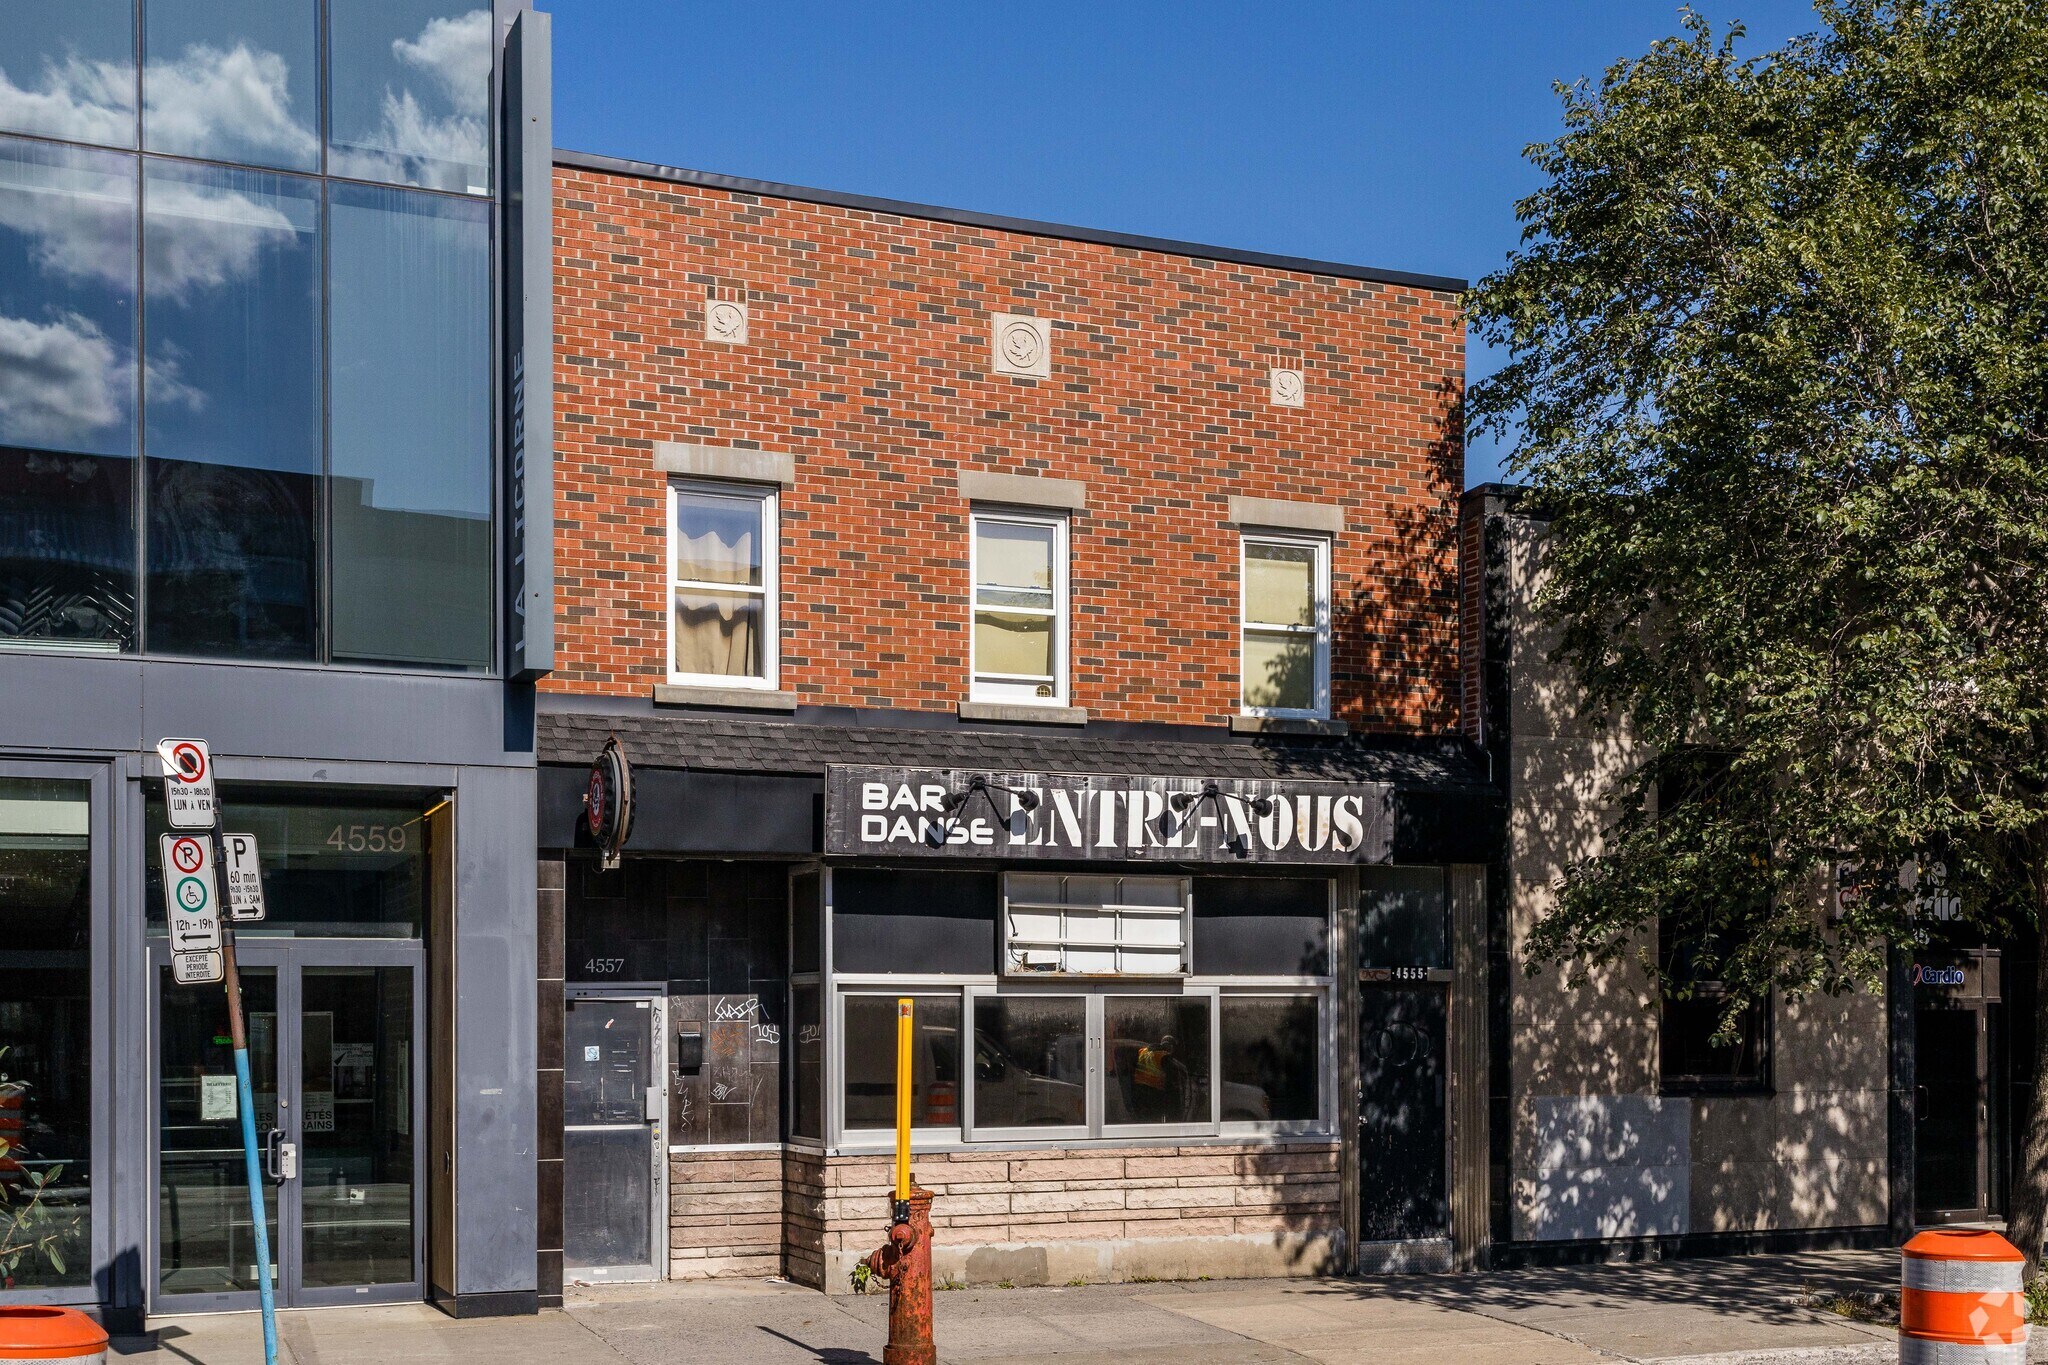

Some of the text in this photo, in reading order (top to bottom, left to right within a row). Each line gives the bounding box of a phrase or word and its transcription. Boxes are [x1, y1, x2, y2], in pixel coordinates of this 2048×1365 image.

[171, 787, 189, 796] 15h30
[194, 787, 211, 796] 18h30
[862, 782, 947, 812] BAR
[173, 799, 188, 810] LUN
[197, 799, 211, 810] VEN
[1007, 785, 1364, 853] ENTRE-NOUS
[861, 814, 994, 845] DANSE
[326, 824, 406, 853] 4559
[232, 838, 247, 868] P
[230, 870, 257, 884] 60 min
[249, 894, 261, 904] SAM
[176, 919, 191, 931] 12h
[199, 918, 214, 930] 19h
[585, 958, 625, 973] 4557
[185, 970, 211, 979] INTERDITE
[1396, 967, 1424, 980] 4555
[1921, 965, 1965, 984] Cardio
[305, 1108, 333, 1120] ÉTÉS
